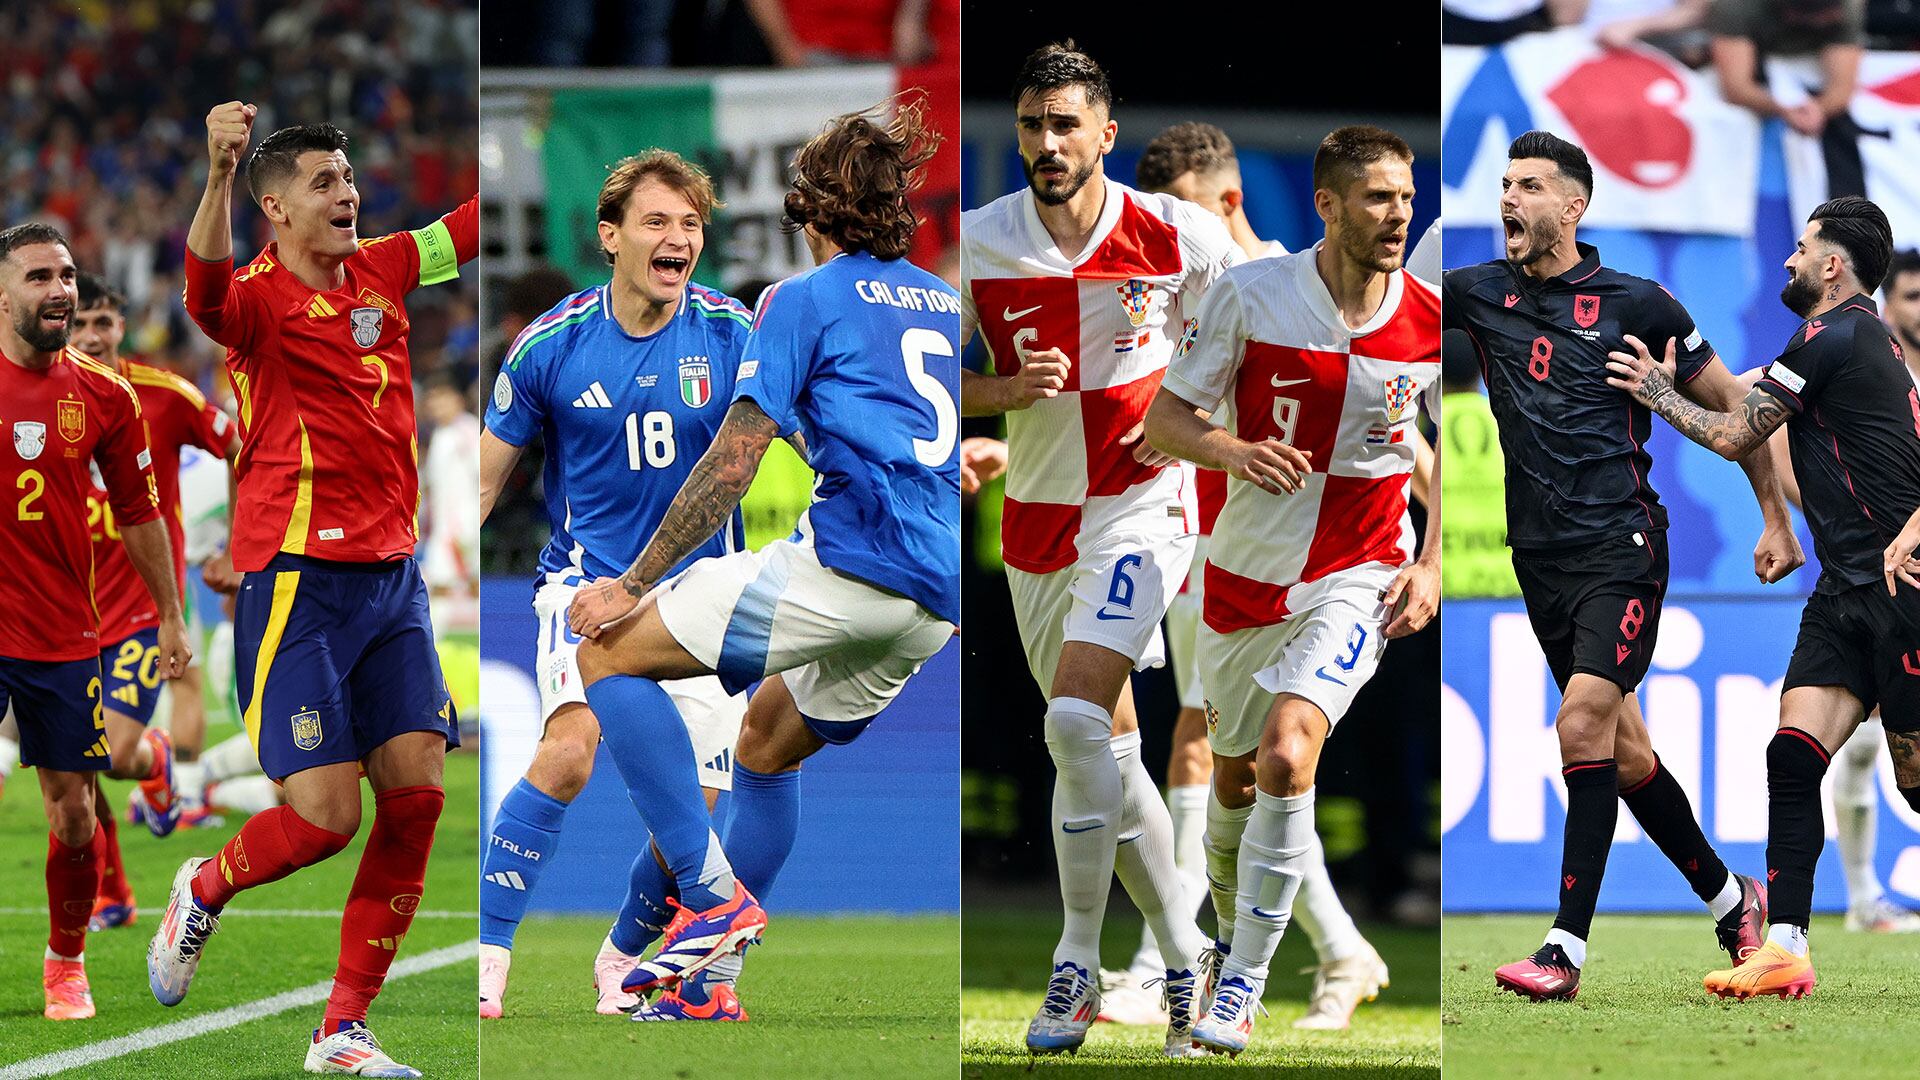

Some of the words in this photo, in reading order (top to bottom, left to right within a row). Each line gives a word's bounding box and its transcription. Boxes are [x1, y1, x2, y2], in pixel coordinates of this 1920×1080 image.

[420, 229, 436, 247] RES
[361, 355, 388, 408] 7
[681, 367, 707, 377] ITALIA
[1530, 335, 1554, 382] 8
[900, 327, 959, 468] 5
[1272, 396, 1301, 446] 9
[625, 410, 676, 471] 18
[16, 468, 45, 521] 2
[1106, 554, 1143, 609] 6
[1619, 598, 1645, 641] 8
[111, 639, 161, 689] 20
[1335, 622, 1368, 673] 9
[86, 676, 105, 730] 2
